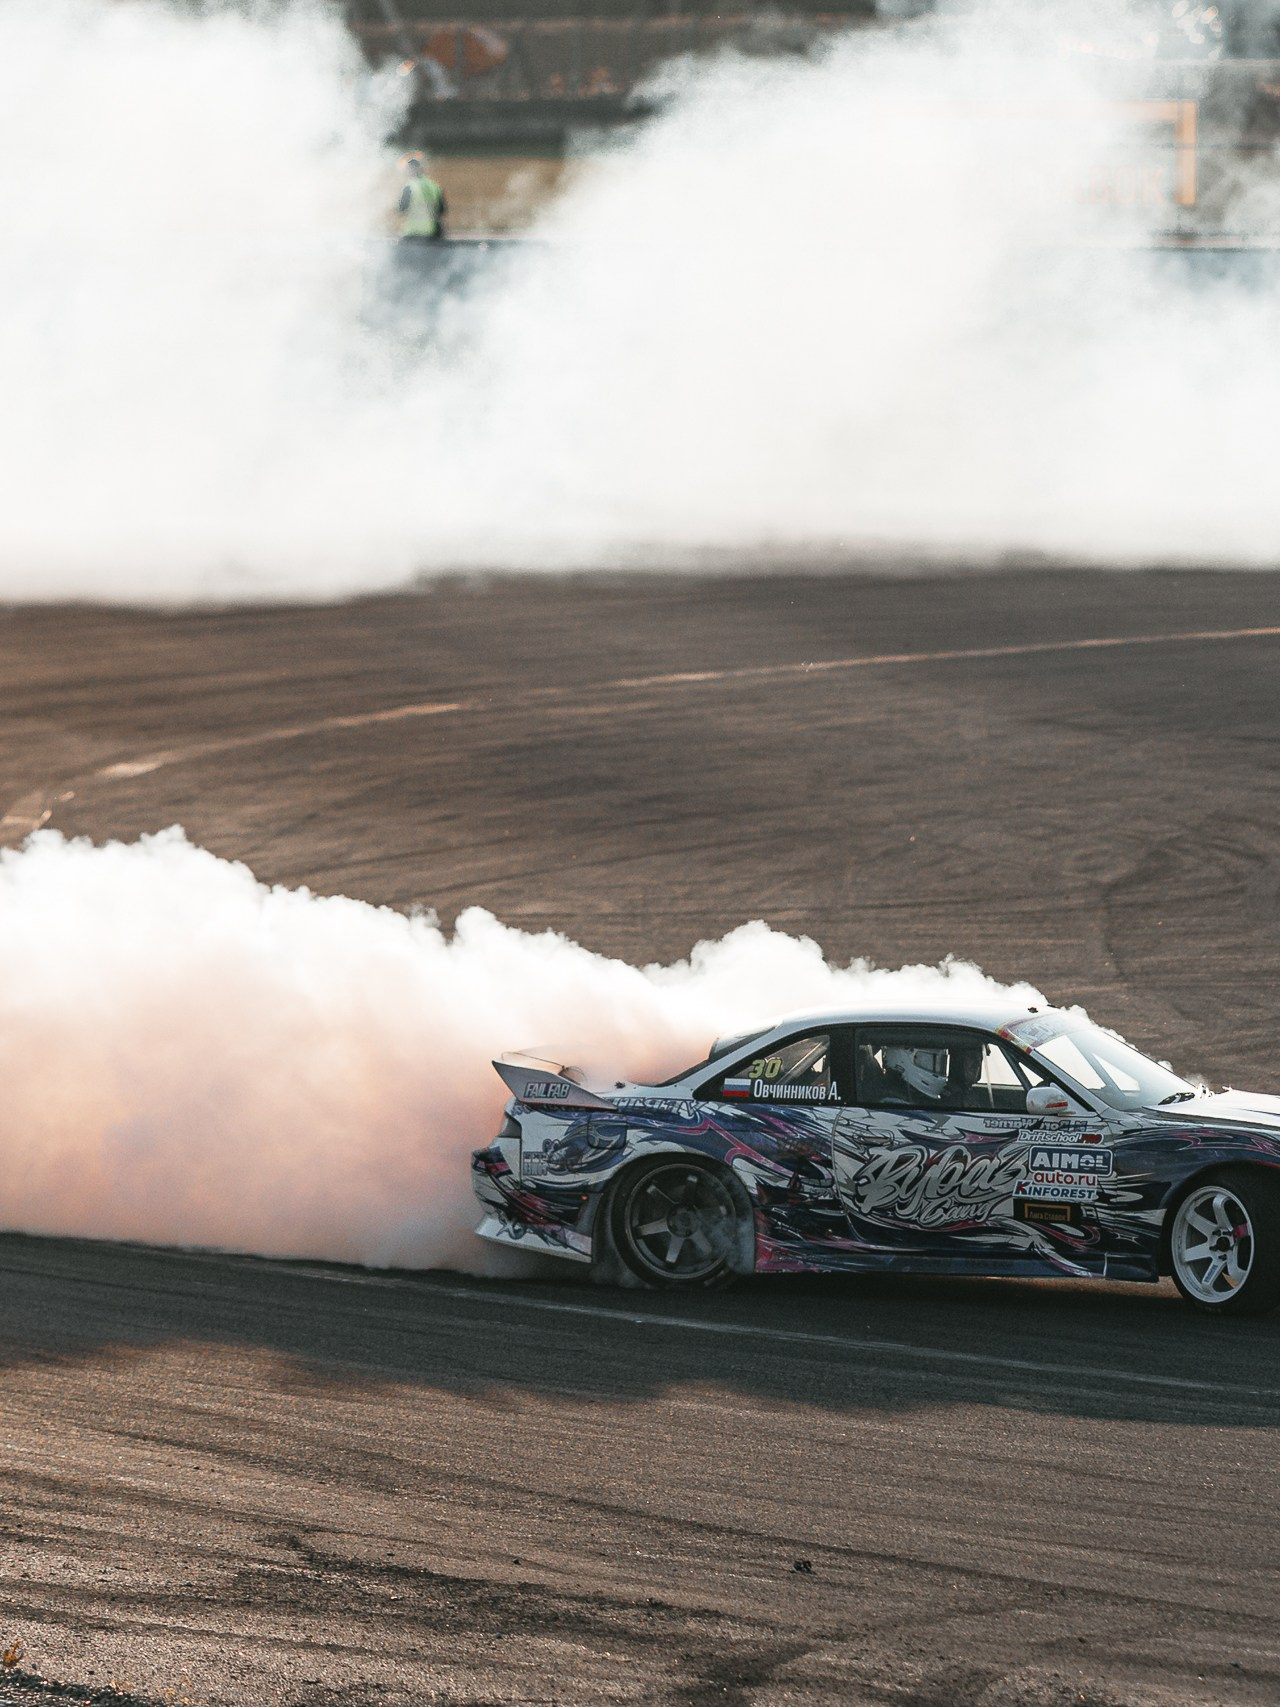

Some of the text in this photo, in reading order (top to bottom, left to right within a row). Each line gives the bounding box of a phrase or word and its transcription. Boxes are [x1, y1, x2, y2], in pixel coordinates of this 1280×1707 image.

[749, 1058, 782, 1079] 30
[1032, 1152, 1108, 1171] AIMOL
[1034, 1171, 1096, 1186] auto.ru
[1014, 1181, 1095, 1199] KINFOREST
